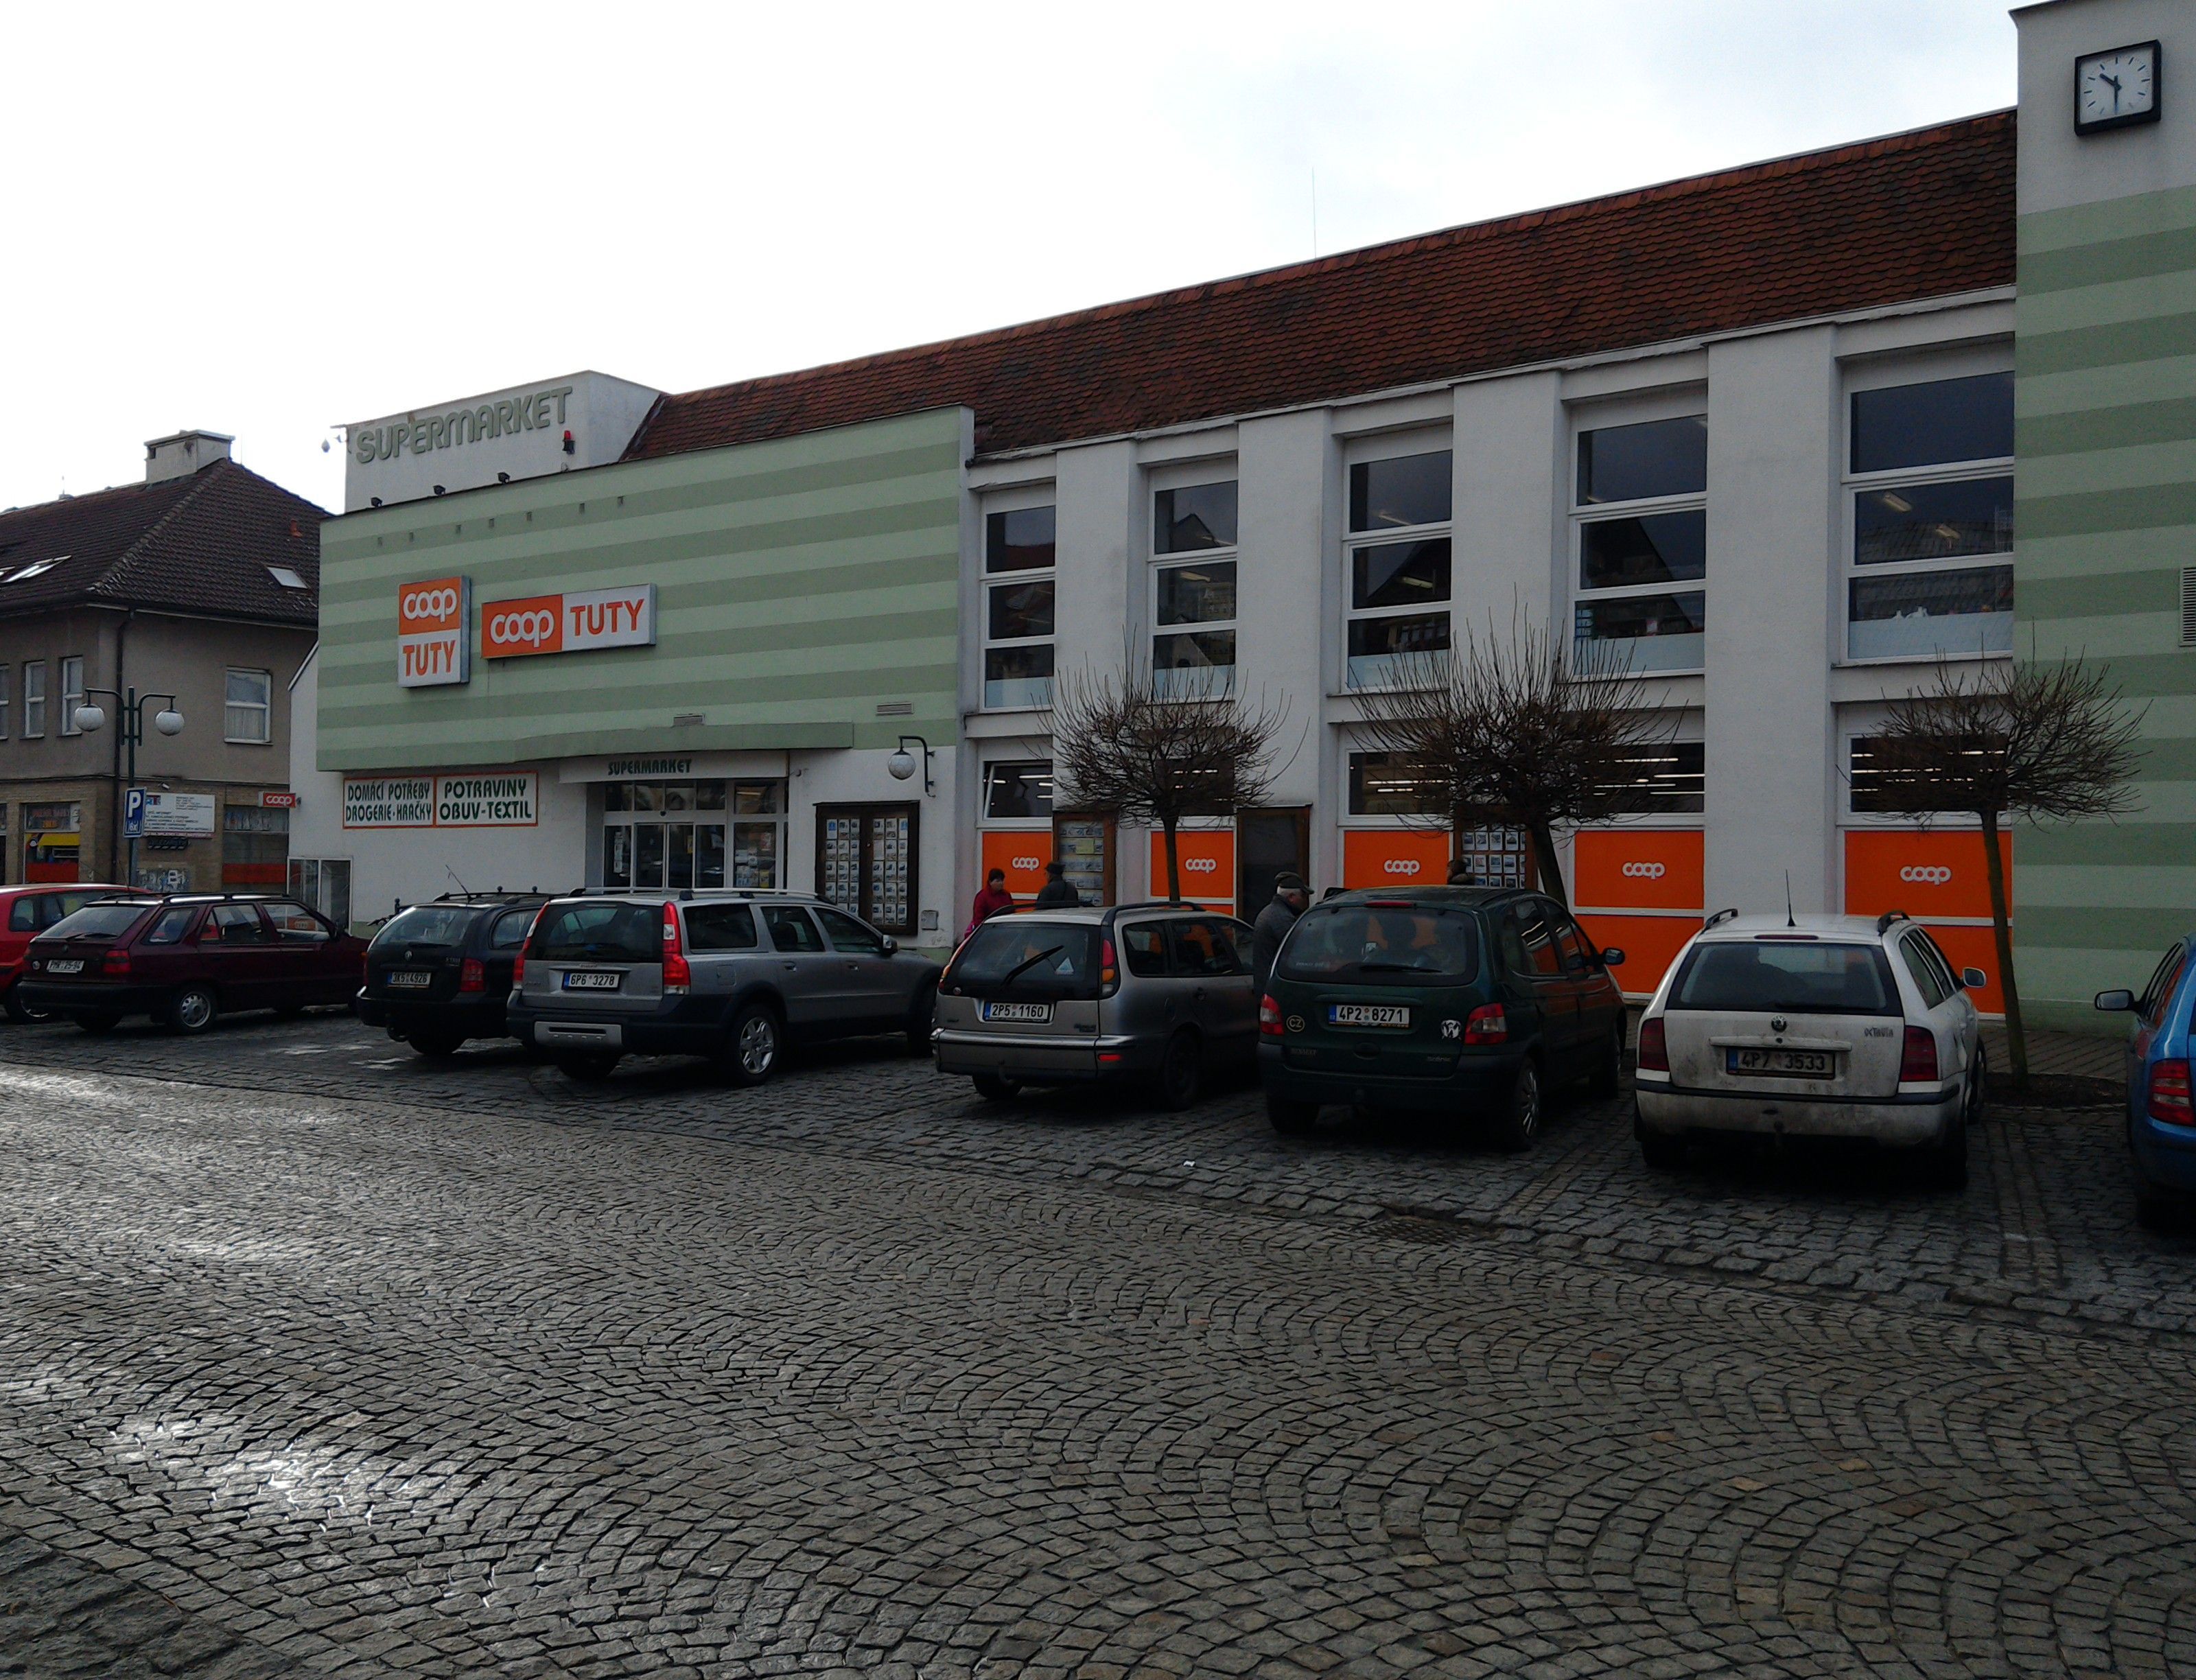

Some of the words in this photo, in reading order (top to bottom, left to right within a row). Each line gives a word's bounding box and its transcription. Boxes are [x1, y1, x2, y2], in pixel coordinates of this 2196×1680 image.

[356, 386, 572, 463] SUPERMARKET
[404, 587, 457, 624] coop
[490, 609, 554, 648] coop
[570, 598, 644, 637] TUTY
[403, 640, 456, 677] TUTY
[608, 759, 692, 775] SUPERMARKET
[348, 782, 384, 802] DOMÁCÍ
[388, 780, 430, 800] POTŘEBY
[445, 779, 526, 799] POTRAVINY
[128, 791, 141, 818] P
[266, 795, 292, 807] coop
[1012, 857, 1039, 871] coop
[1185, 858, 1217, 874] coop
[1383, 859, 1421, 876] coop
[1622, 862, 1666, 879] coop
[1900, 866, 1952, 885] coop
[593, 975, 614, 986] 3278
[992, 1004, 1010, 1017] 2P5
[1020, 1005, 1043, 1018] 1160
[1340, 1006, 1362, 1021] 4P2
[1371, 1007, 1403, 1023] 8271
[1741, 1051, 1770, 1069] 4P7
[1784, 1053, 1825, 1071] 3533
